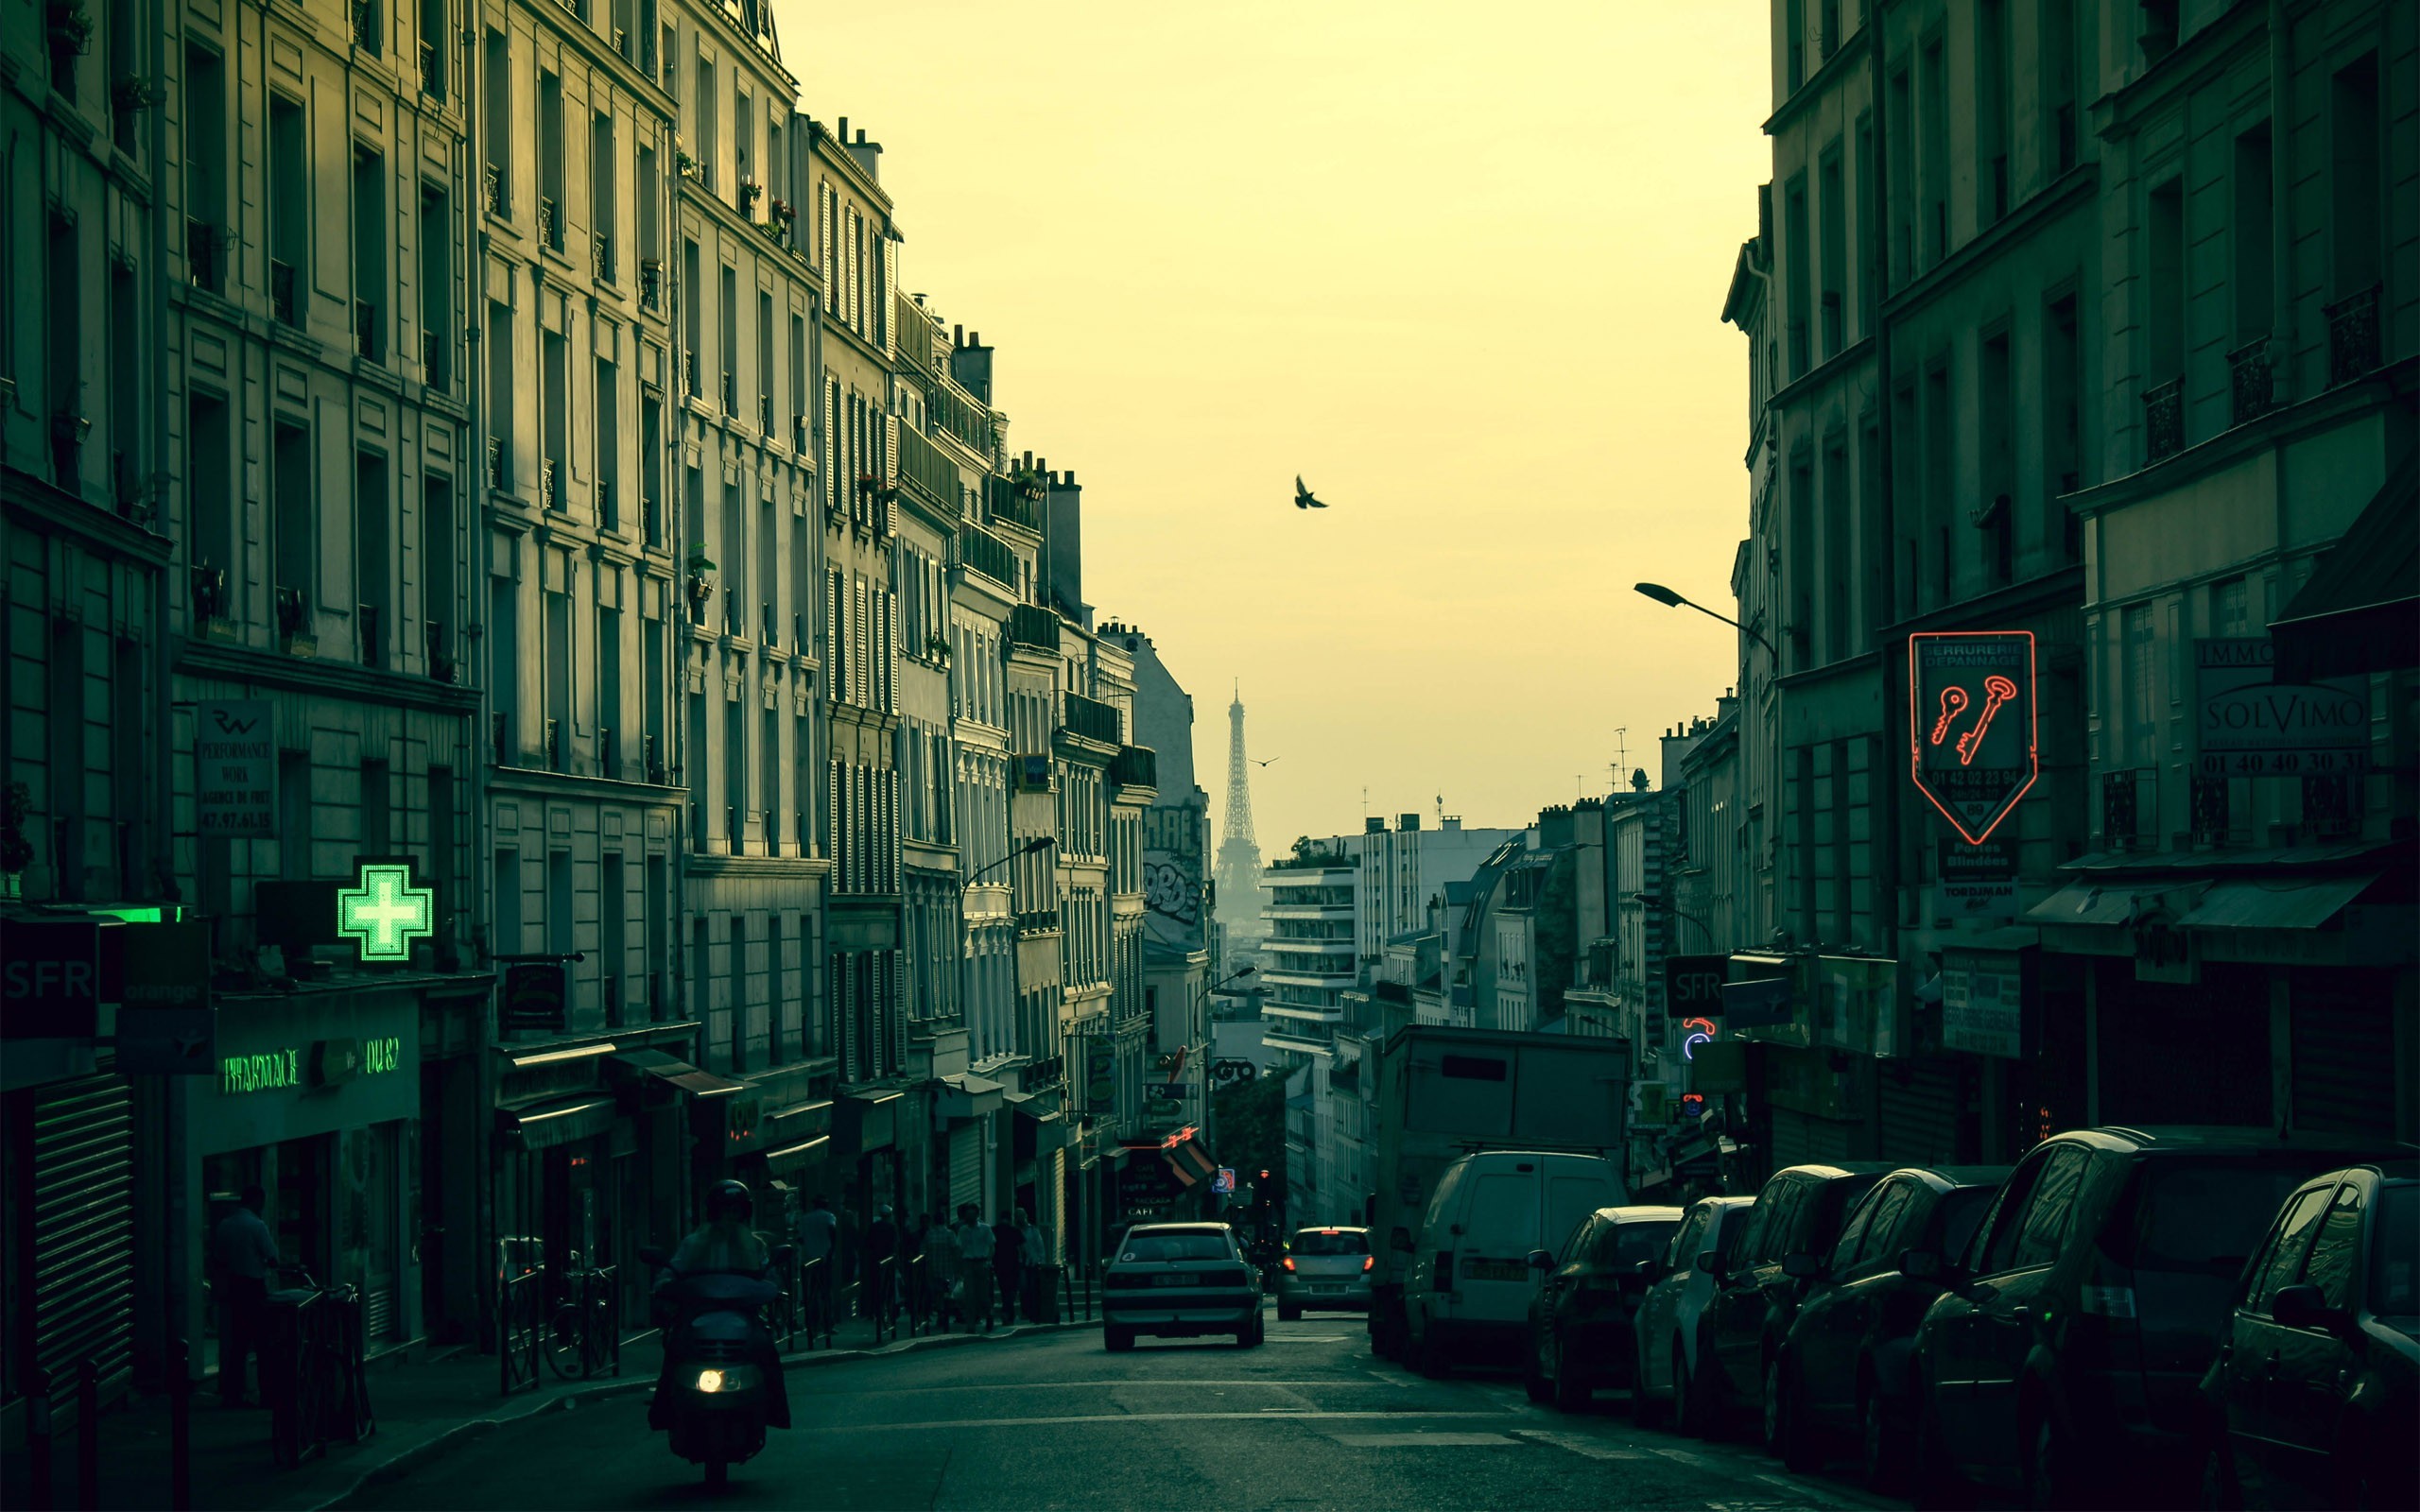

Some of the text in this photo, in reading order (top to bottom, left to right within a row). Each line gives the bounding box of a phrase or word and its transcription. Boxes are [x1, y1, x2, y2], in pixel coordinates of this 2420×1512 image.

[1923, 644, 2023, 657] SERRURERIE
[2207, 695, 2364, 734] SOLVIMO
[202, 742, 269, 760] PERFORMANCE
[2204, 752, 2364, 773] 01 40 40 30 31
[221, 766, 250, 783] WORK
[1932, 770, 2017, 785] 01 42 02 23 94
[202, 790, 271, 805] AGENCE DE FRET
[201, 812, 271, 829] 47.97.61.15
[1954, 841, 2000, 853] Portes
[1947, 855, 2009, 867] Blindées
[1945, 886, 2013, 898] TORDJMAN
[5, 960, 93, 999] SFR
[1676, 972, 1720, 1001] SFR
[124, 984, 198, 1004] orange
[367, 1039, 384, 1074] DU
[386, 1037, 401, 1072] 82
[225, 1049, 301, 1093] PHARMACIE
